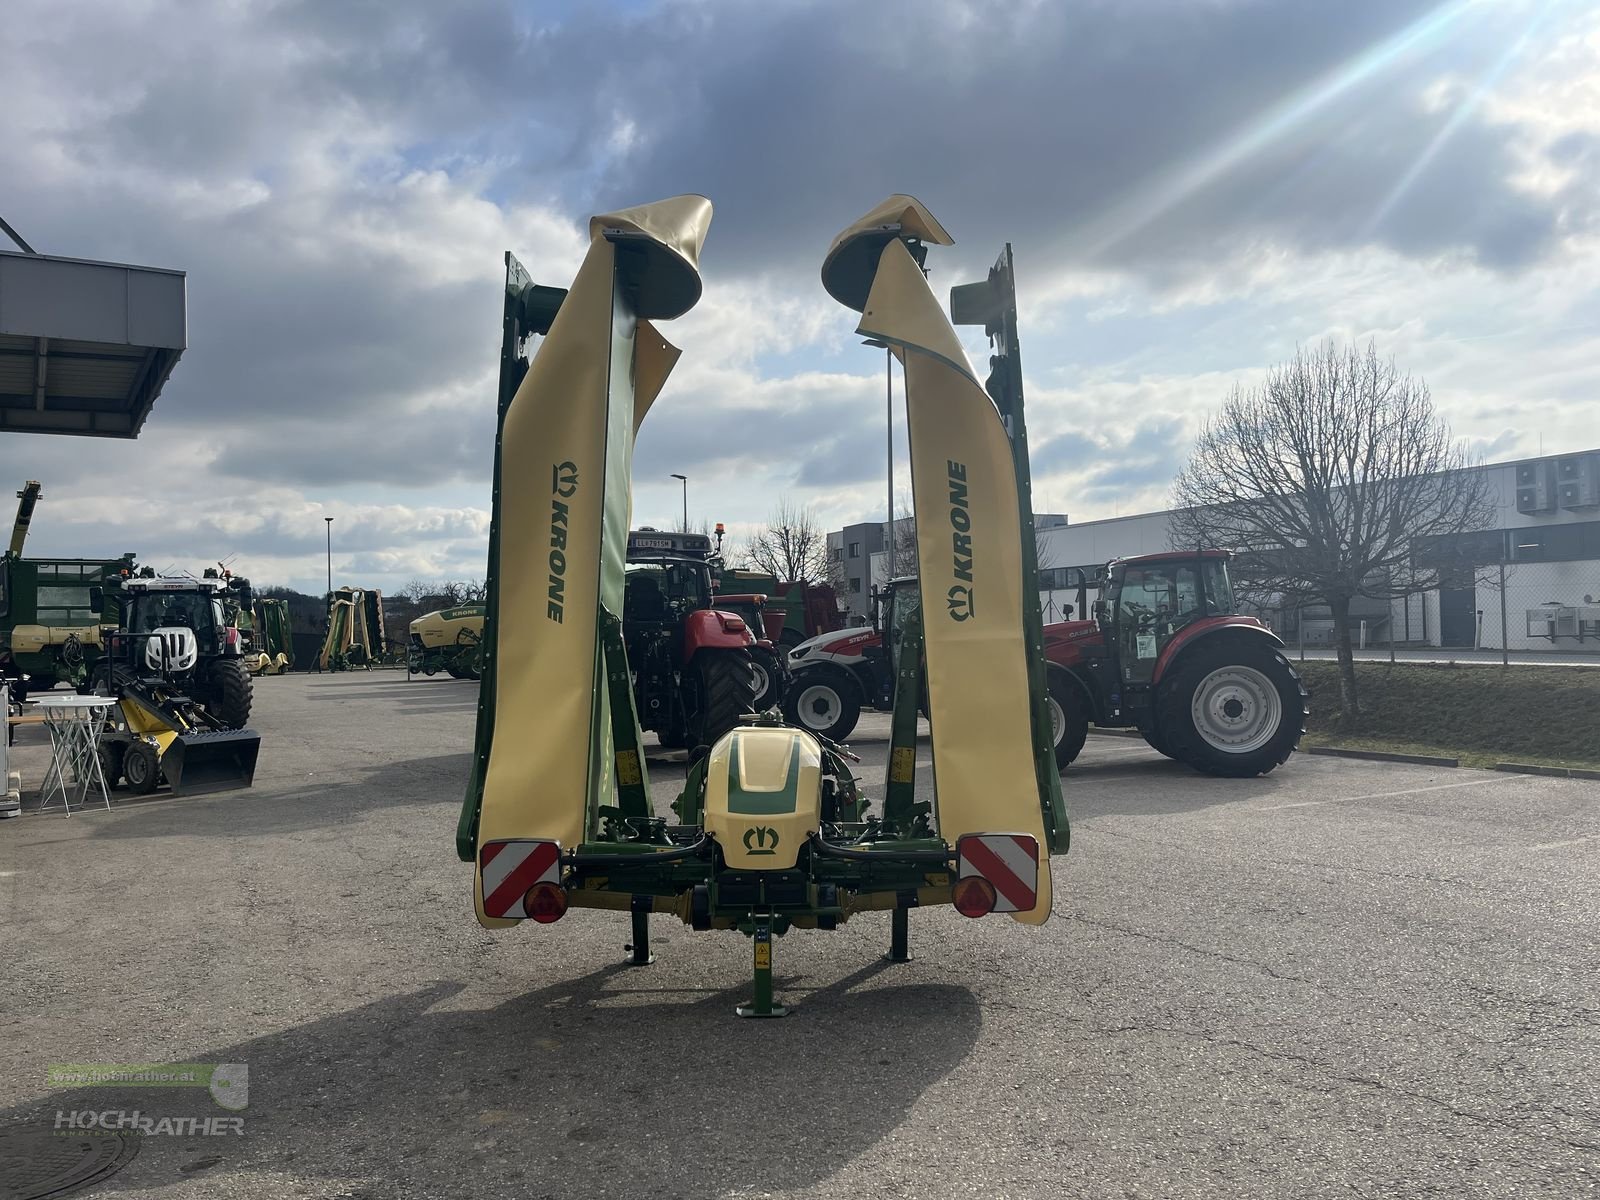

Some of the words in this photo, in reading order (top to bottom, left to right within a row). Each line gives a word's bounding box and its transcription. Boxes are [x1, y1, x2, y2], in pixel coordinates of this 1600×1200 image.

[947, 460, 973, 582] KRONE
[547, 500, 569, 624] KRONE
[452, 609, 478, 617] KRONE
[848, 633, 870, 644] STEYR
